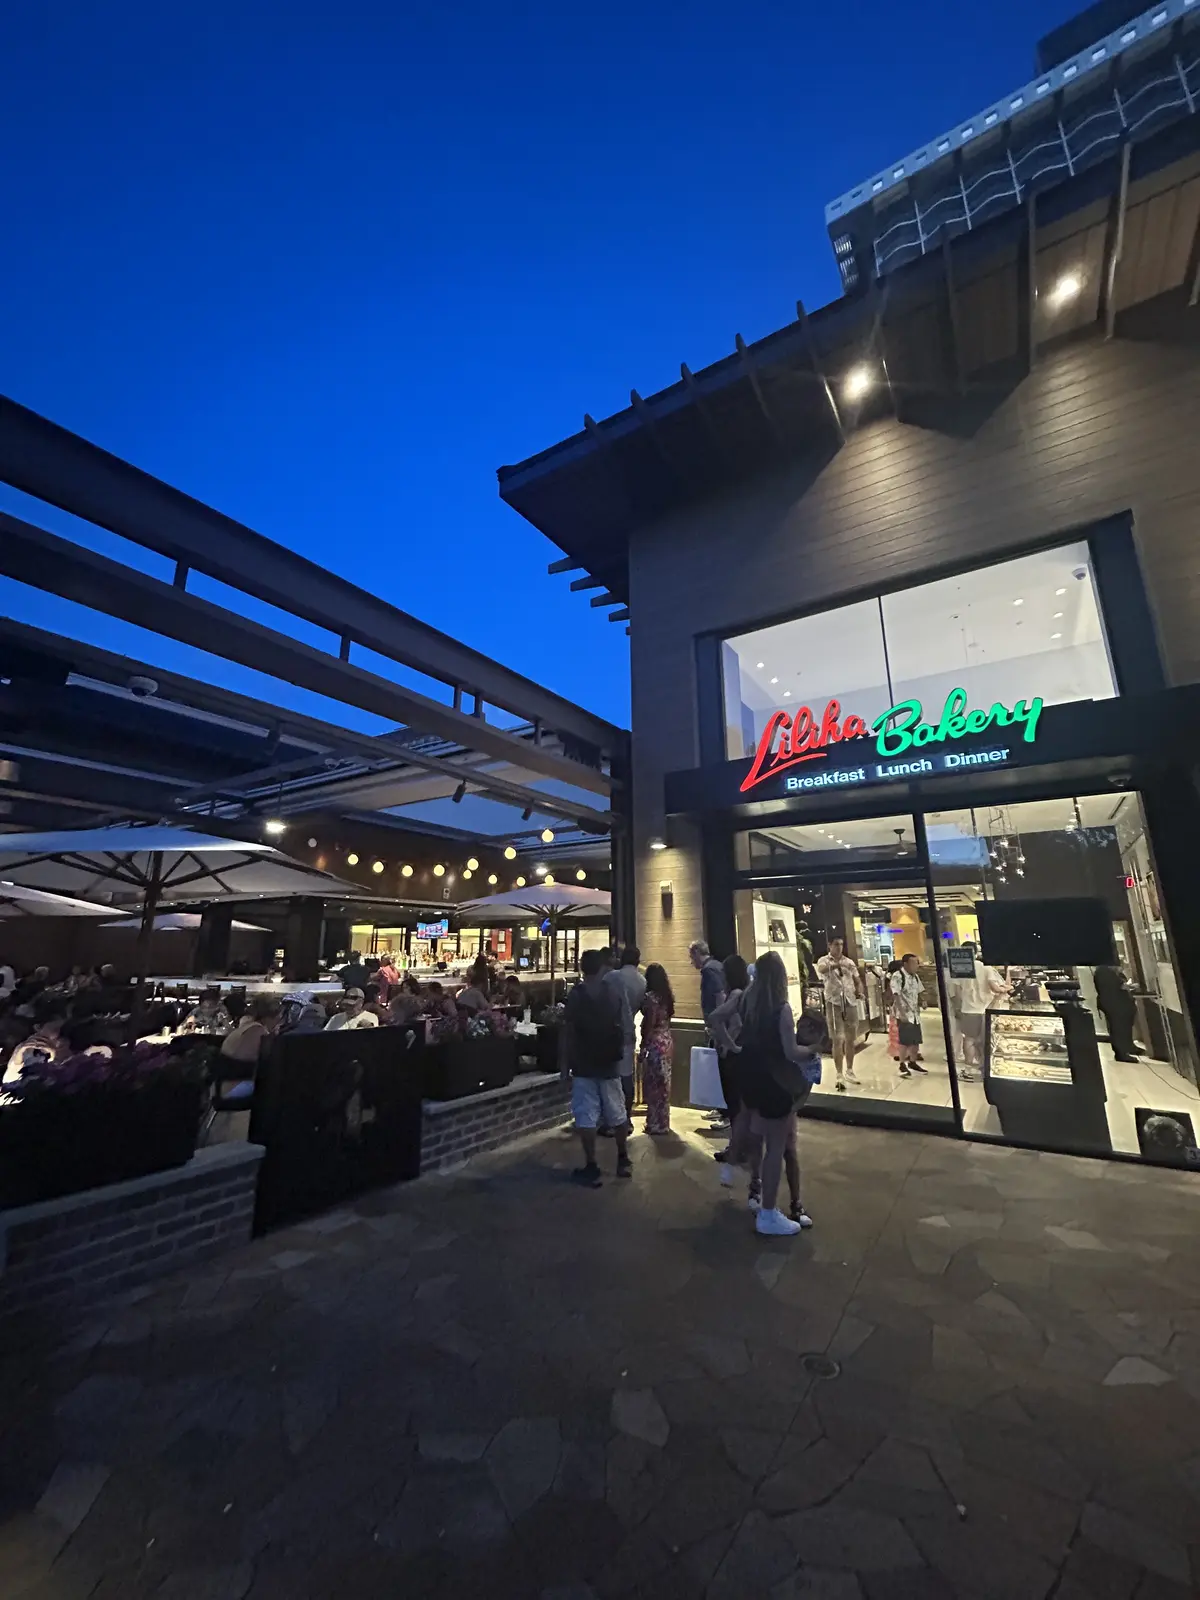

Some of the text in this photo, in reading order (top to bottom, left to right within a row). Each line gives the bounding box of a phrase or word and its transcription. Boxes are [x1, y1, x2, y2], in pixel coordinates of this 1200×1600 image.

[740, 688, 1044, 792] Liliha Bakery
[786, 748, 1010, 791] Breakfast Lunch Dinner
